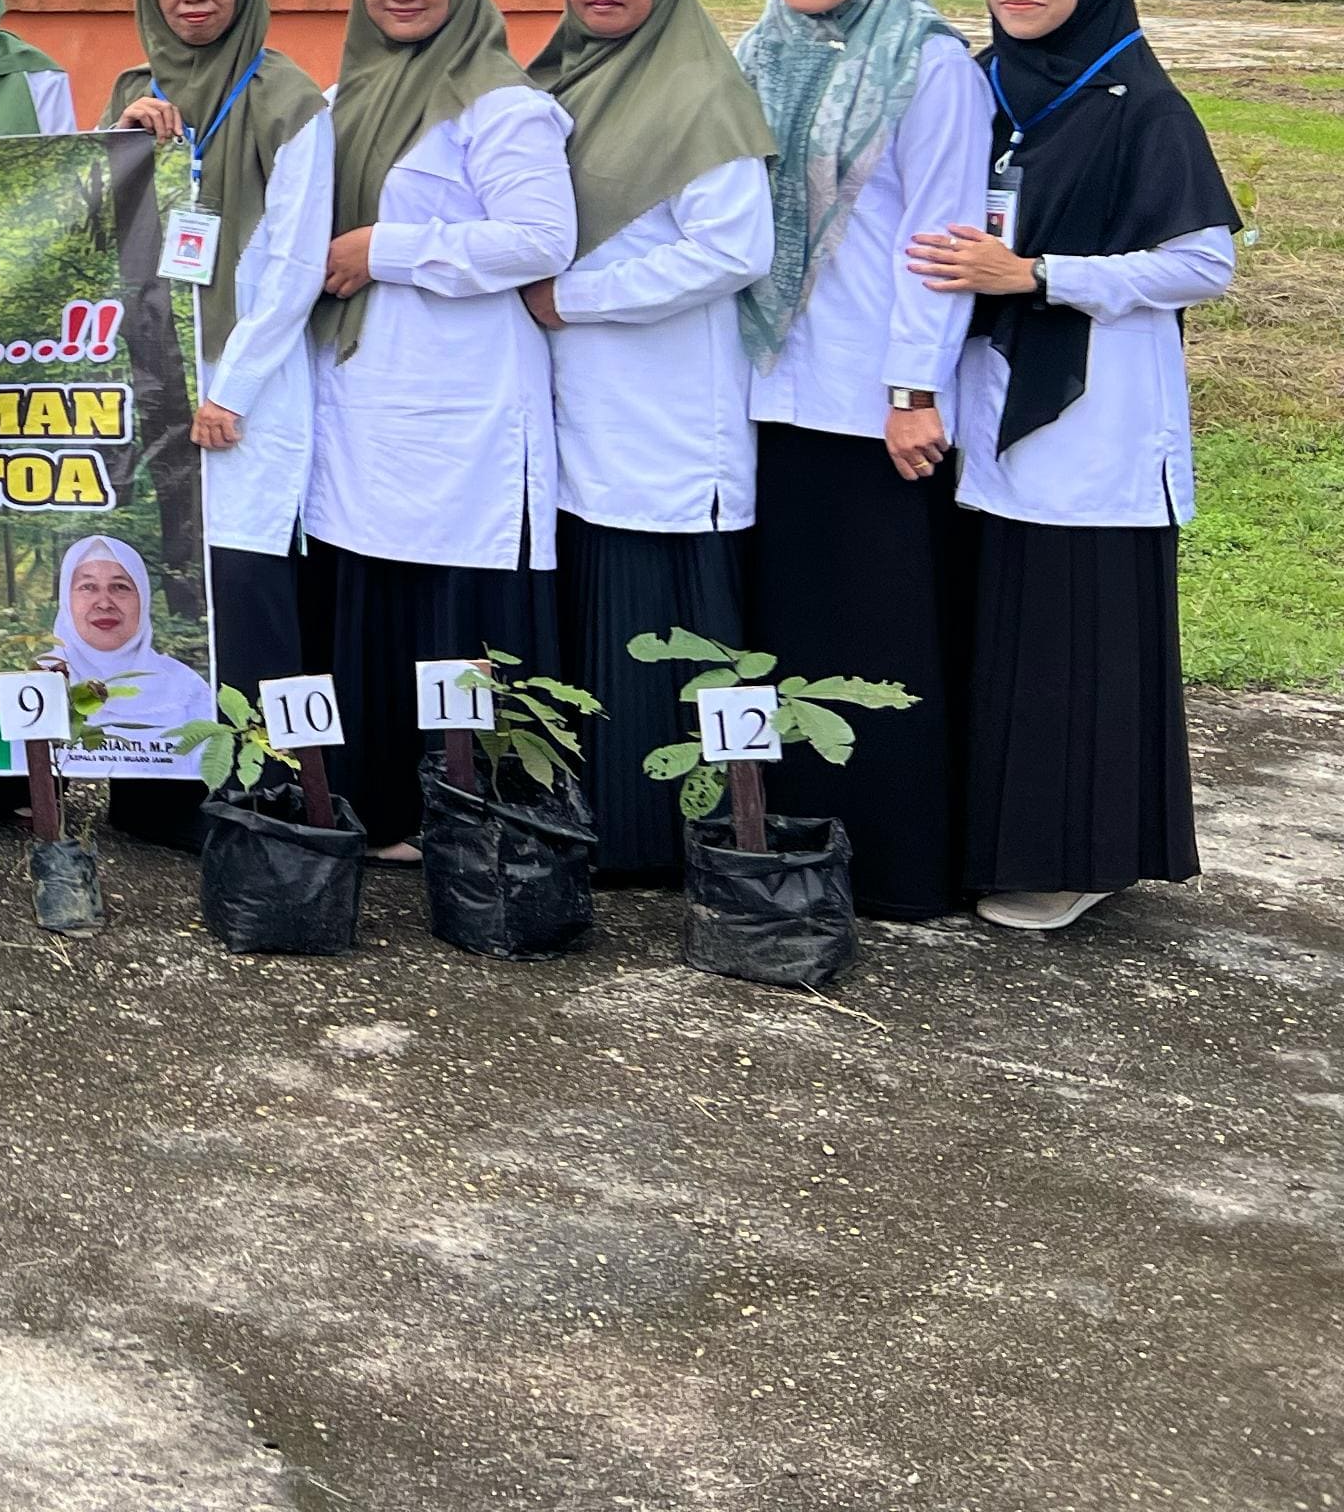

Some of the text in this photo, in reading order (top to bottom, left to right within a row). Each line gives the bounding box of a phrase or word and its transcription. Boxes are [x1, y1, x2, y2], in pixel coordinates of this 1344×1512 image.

[17, 685, 45, 728] 9
[275, 691, 333, 736] 10
[711, 707, 772, 753] 12
